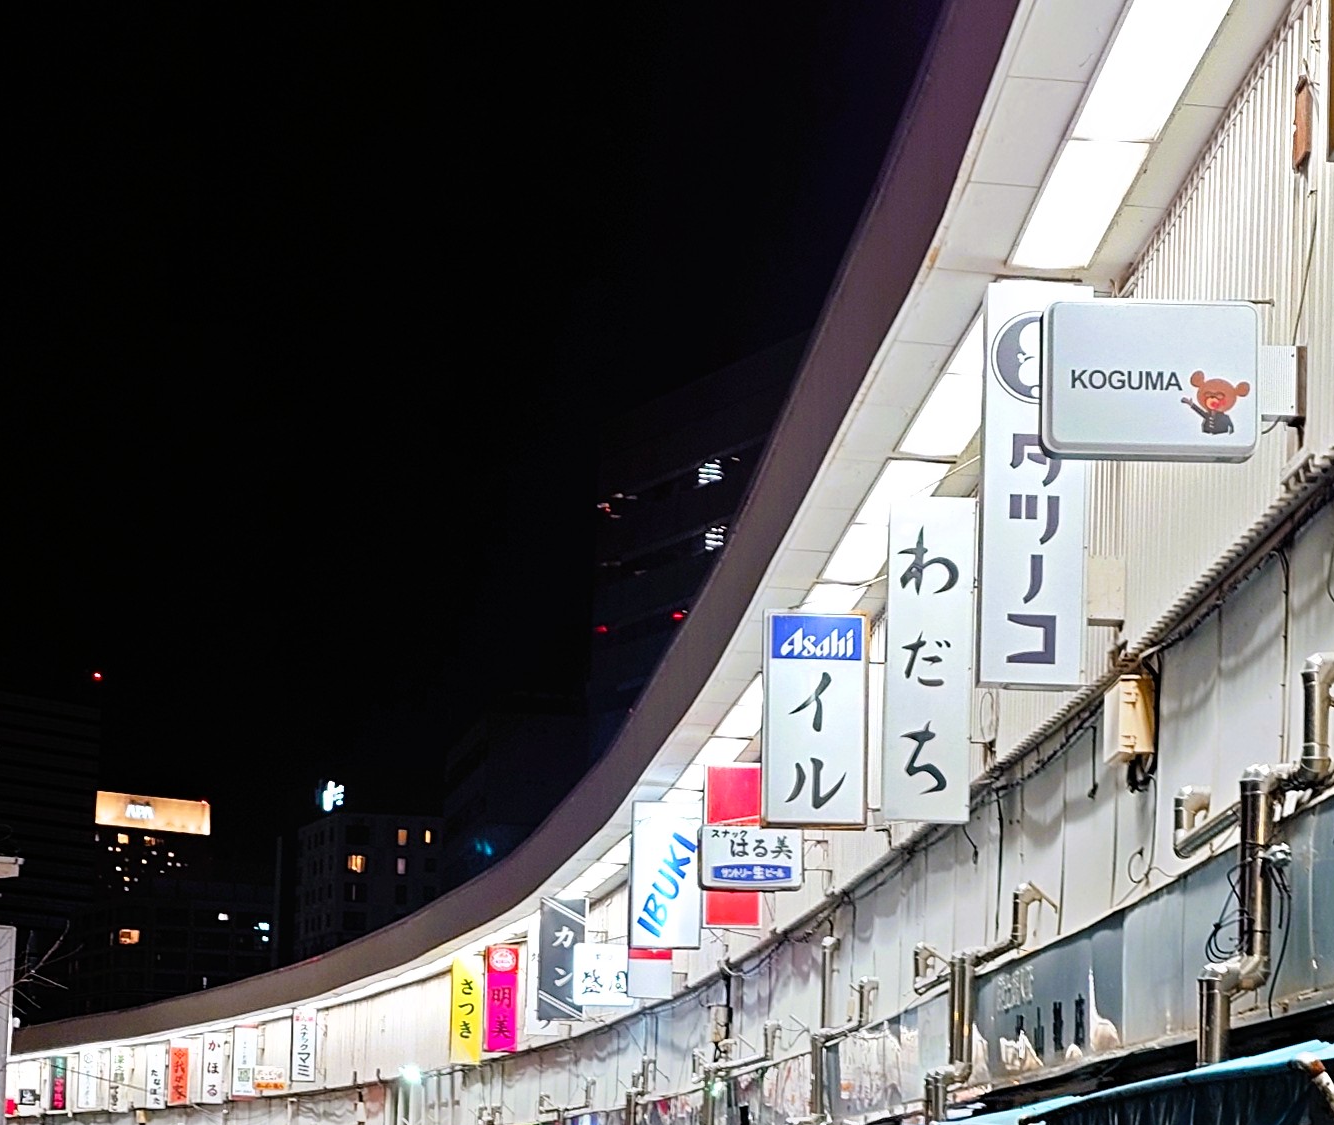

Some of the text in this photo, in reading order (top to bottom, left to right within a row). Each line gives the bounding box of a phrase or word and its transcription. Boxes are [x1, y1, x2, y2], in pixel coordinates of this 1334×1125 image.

[1070, 369, 1183, 392] KOGUMA
[1005, 433, 1061, 665] タツノコ
[779, 626, 855, 659] Asahi
[897, 525, 960, 795] わだち
[785, 671, 846, 810] イル
[711, 829, 748, 838] スナック
[730, 836, 793, 860] はる美
[637, 832, 698, 938] IBUKI
[458, 978, 475, 1039] さつき
[491, 987, 512, 1039] 明美
[207, 1040, 220, 1097] かほる
